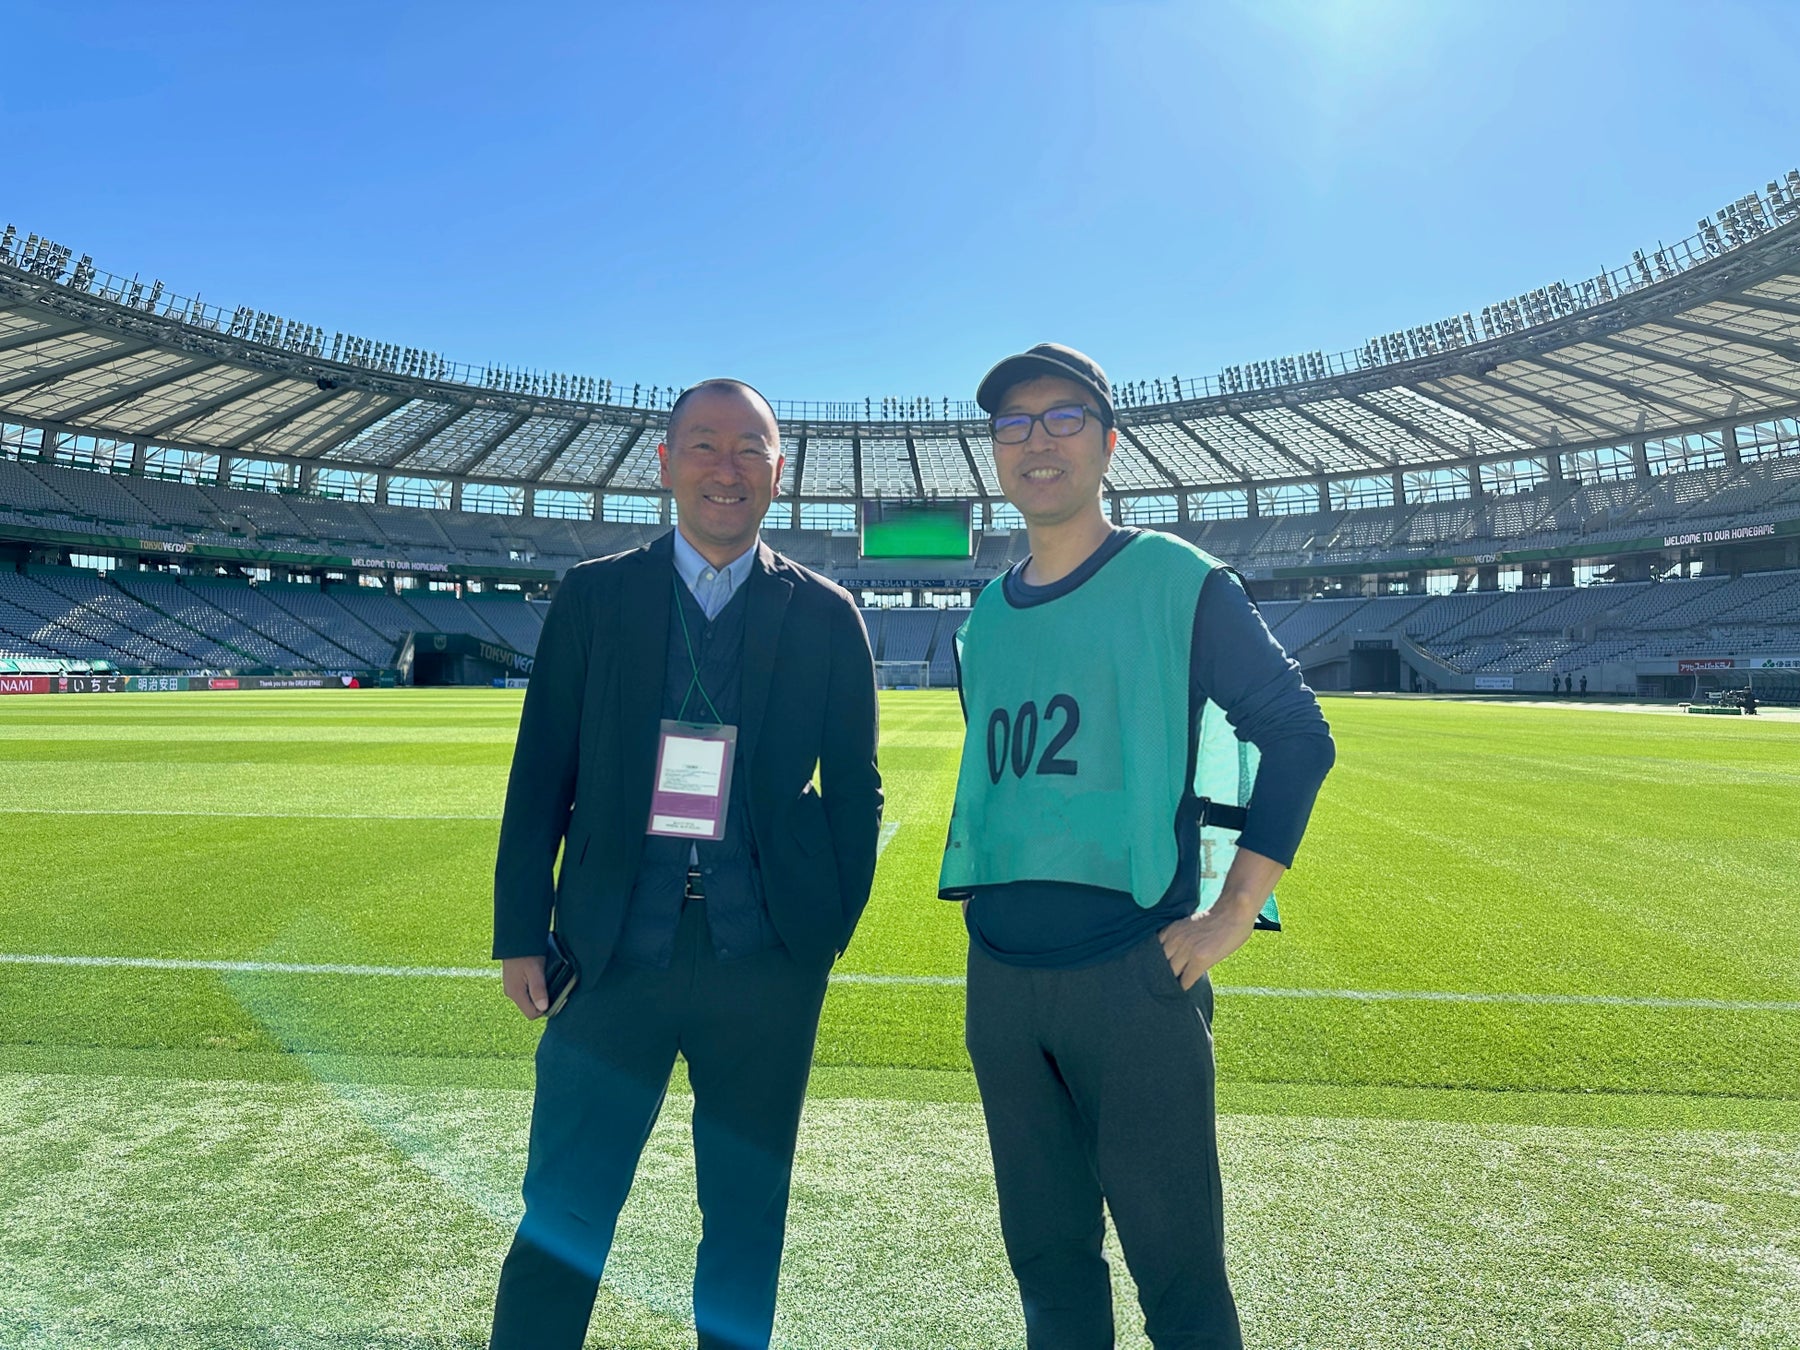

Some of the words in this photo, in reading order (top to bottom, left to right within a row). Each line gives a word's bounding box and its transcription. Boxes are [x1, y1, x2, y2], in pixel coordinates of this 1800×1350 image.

[1663, 533, 1701, 547] WELCOME
[1702, 531, 1713, 542] TO
[1714, 529, 1731, 541] OUR
[1731, 523, 1775, 539] HOMEGAME
[351, 558, 385, 568] WELCOME
[386, 560, 395, 568] TO
[396, 560, 411, 569] OUR
[411, 561, 449, 572] HOMEGAME
[480, 642, 514, 667] TOKYO
[73, 677, 118, 692] いちご
[138, 677, 178, 691] 明治安田
[987, 693, 1081, 786] 002
